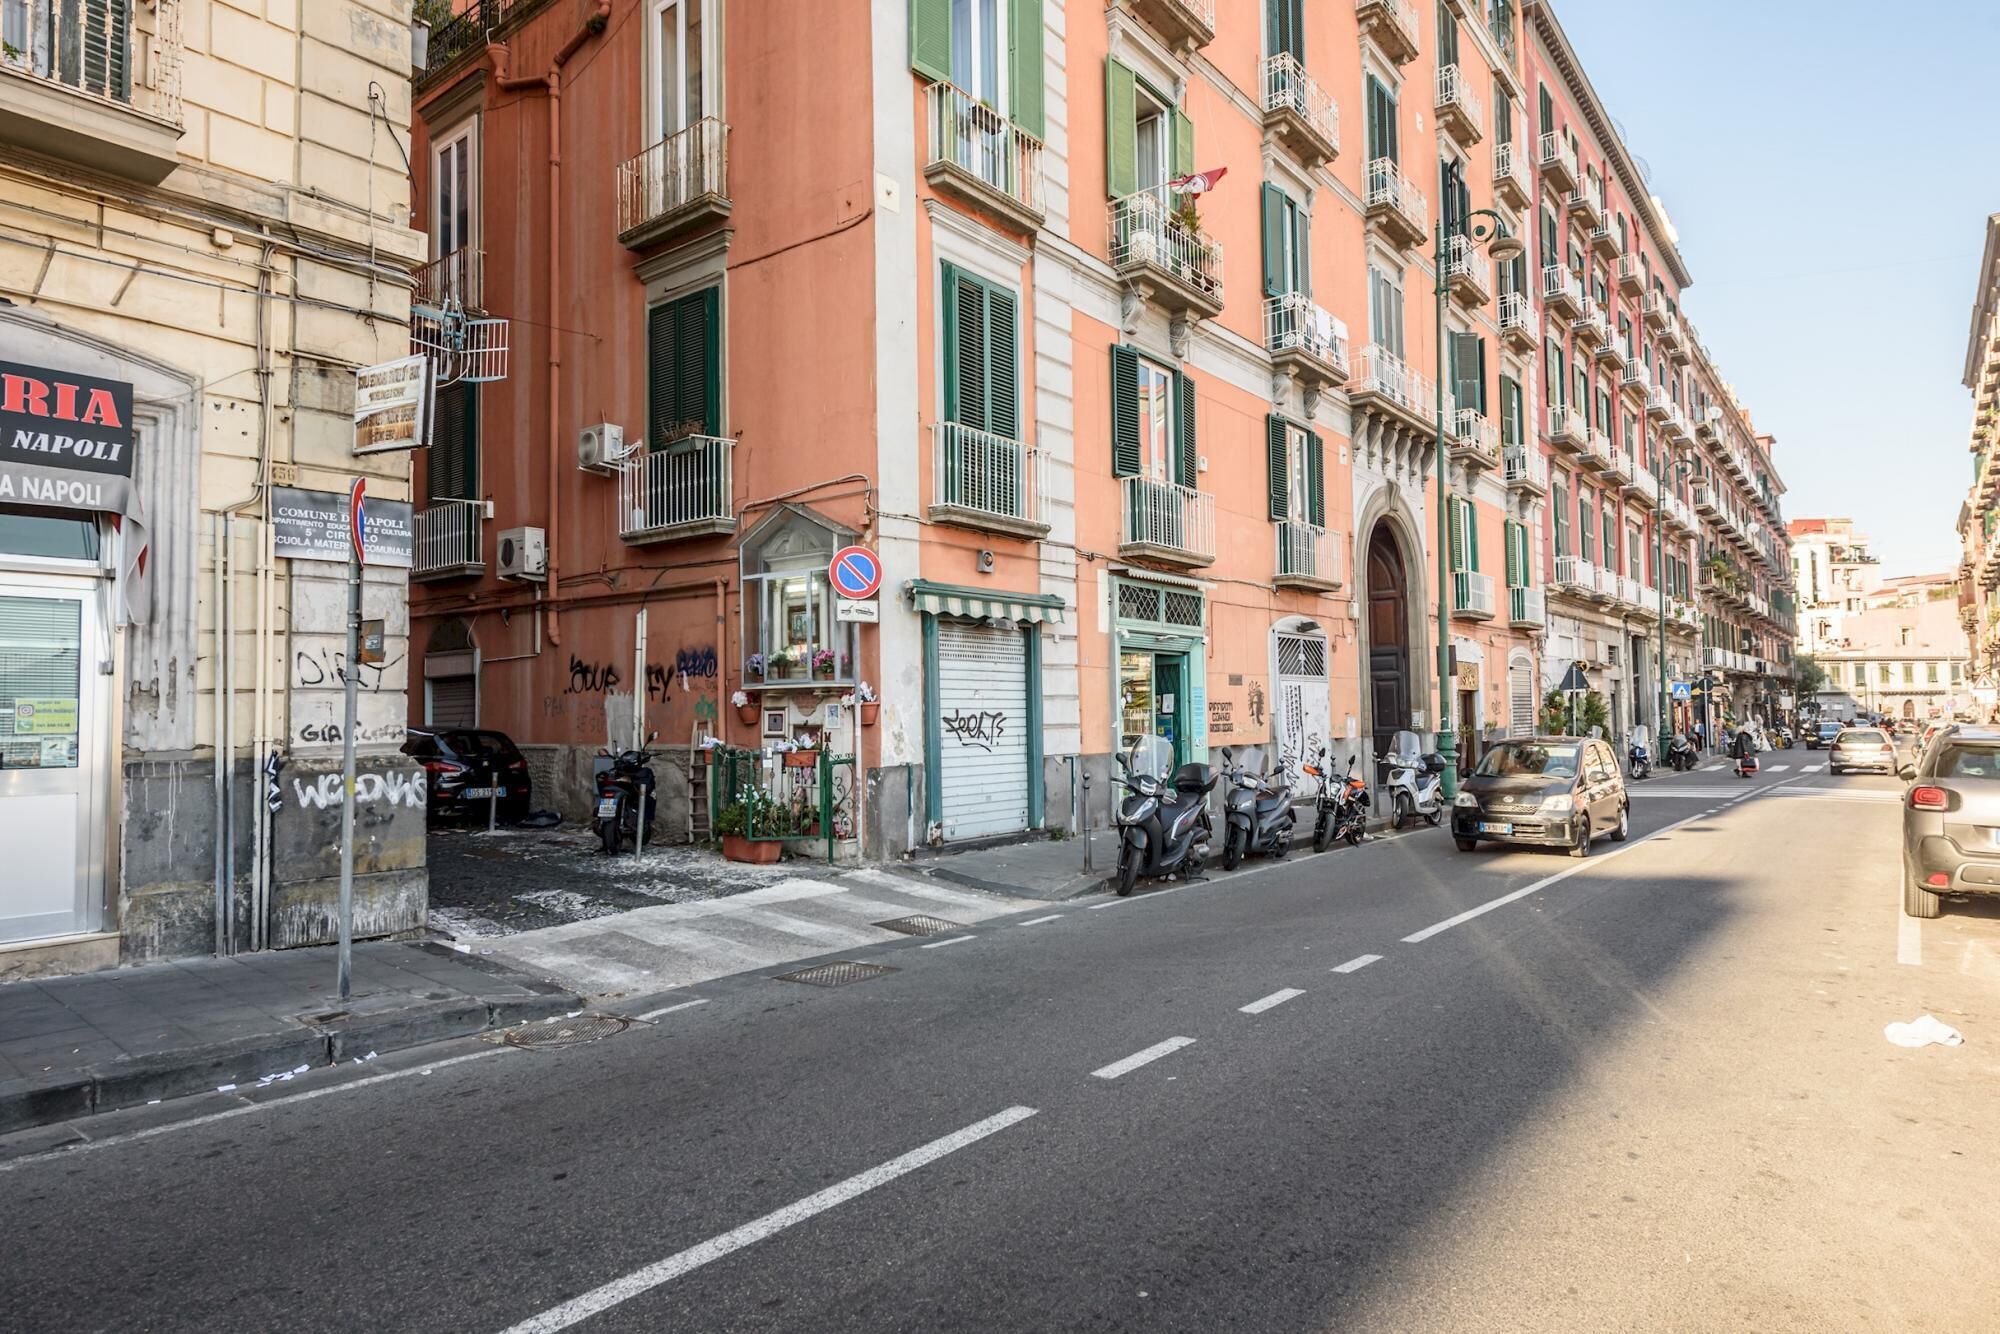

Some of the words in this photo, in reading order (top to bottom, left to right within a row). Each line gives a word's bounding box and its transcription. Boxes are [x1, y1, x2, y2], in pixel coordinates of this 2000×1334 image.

[1, 373, 122, 428] RIA
[11, 430, 123, 461] NAPOLI
[22, 476, 101, 505] NAPOLI
[278, 507, 337, 522] COMUNE
